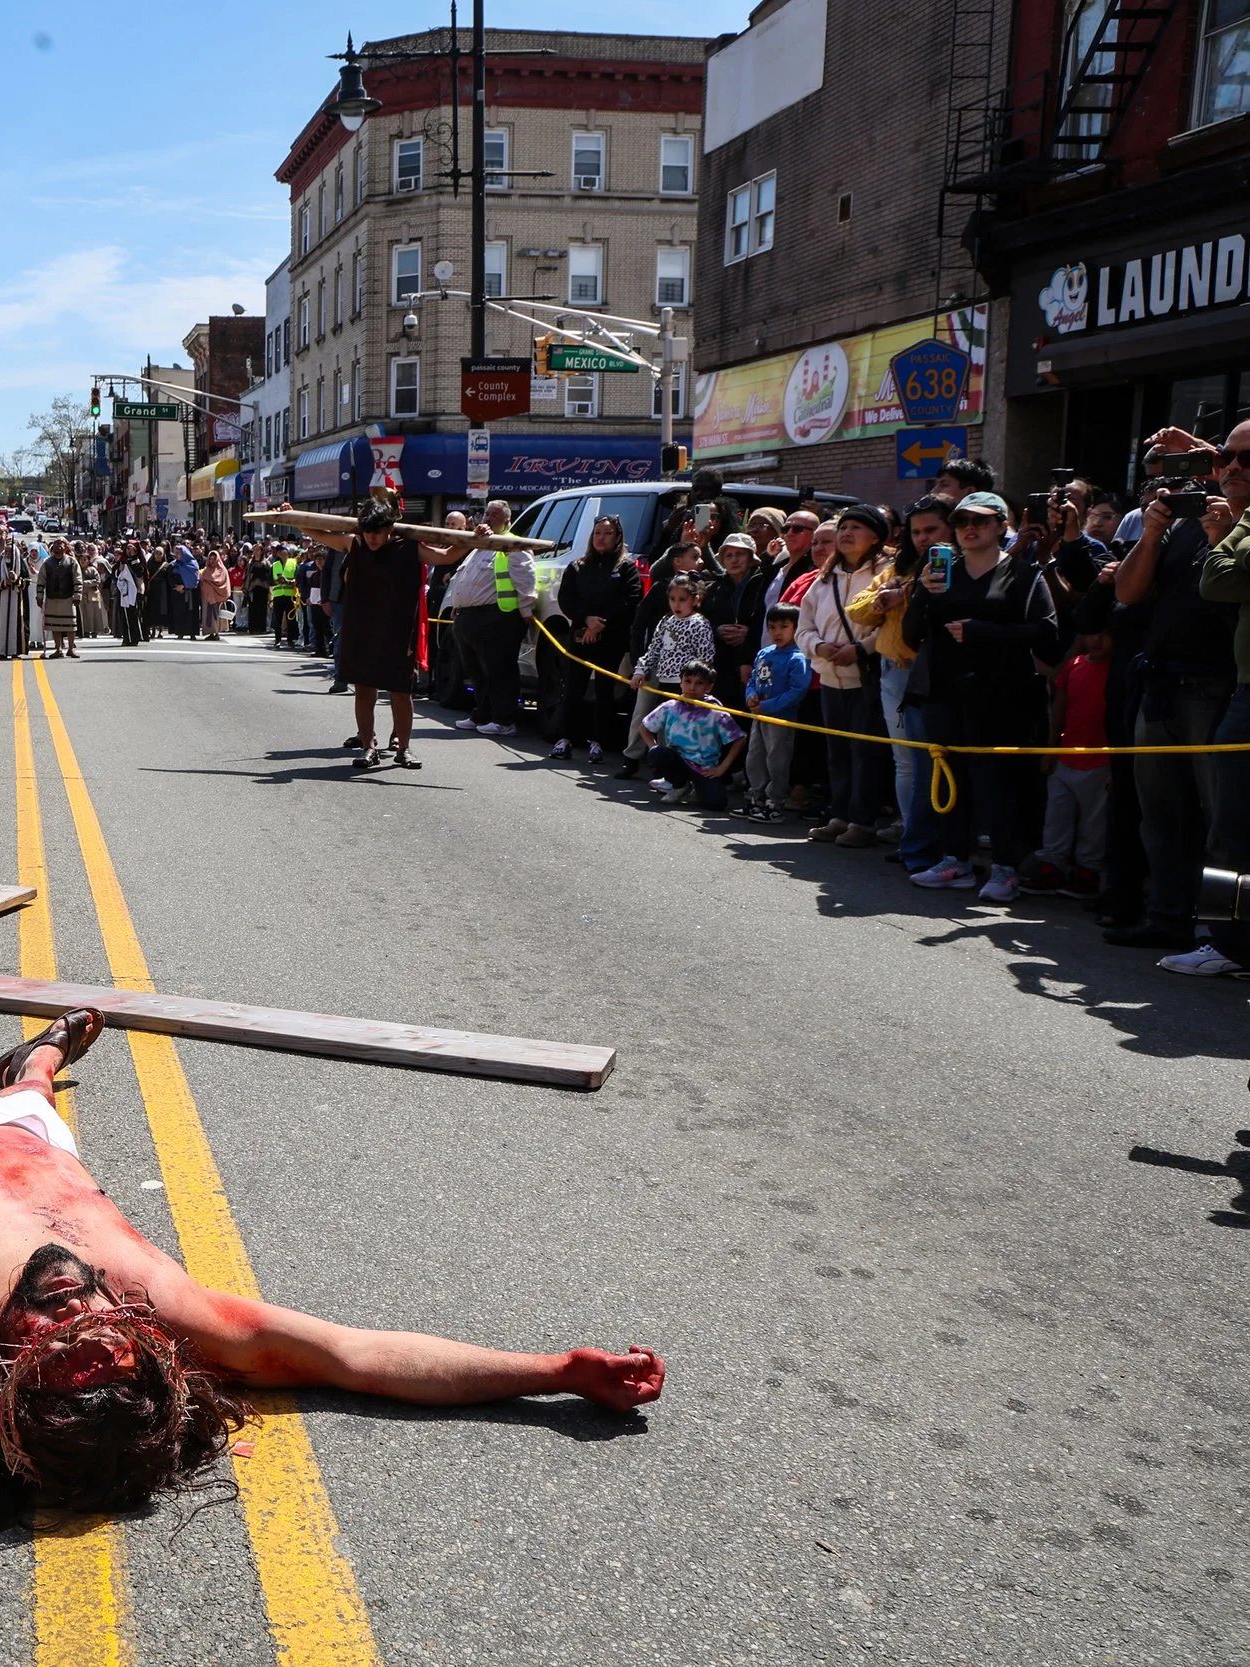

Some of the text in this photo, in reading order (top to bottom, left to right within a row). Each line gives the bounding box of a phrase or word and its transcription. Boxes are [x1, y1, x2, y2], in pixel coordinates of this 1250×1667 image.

[1097, 233, 1250, 327] LAUND
[1052, 304, 1086, 330] Angel
[565, 357, 607, 370] MEXICO
[910, 353, 951, 365] PASSAIC
[471, 363, 521, 372] passaic county
[478, 382, 509, 392] County
[906, 368, 957, 400] 638
[478, 392, 516, 402] Complex
[123, 405, 156, 416] Grand
[864, 407, 904, 424] We Delive
[910, 404, 952, 416] COUNTY
[504, 455, 653, 479] IRVING
